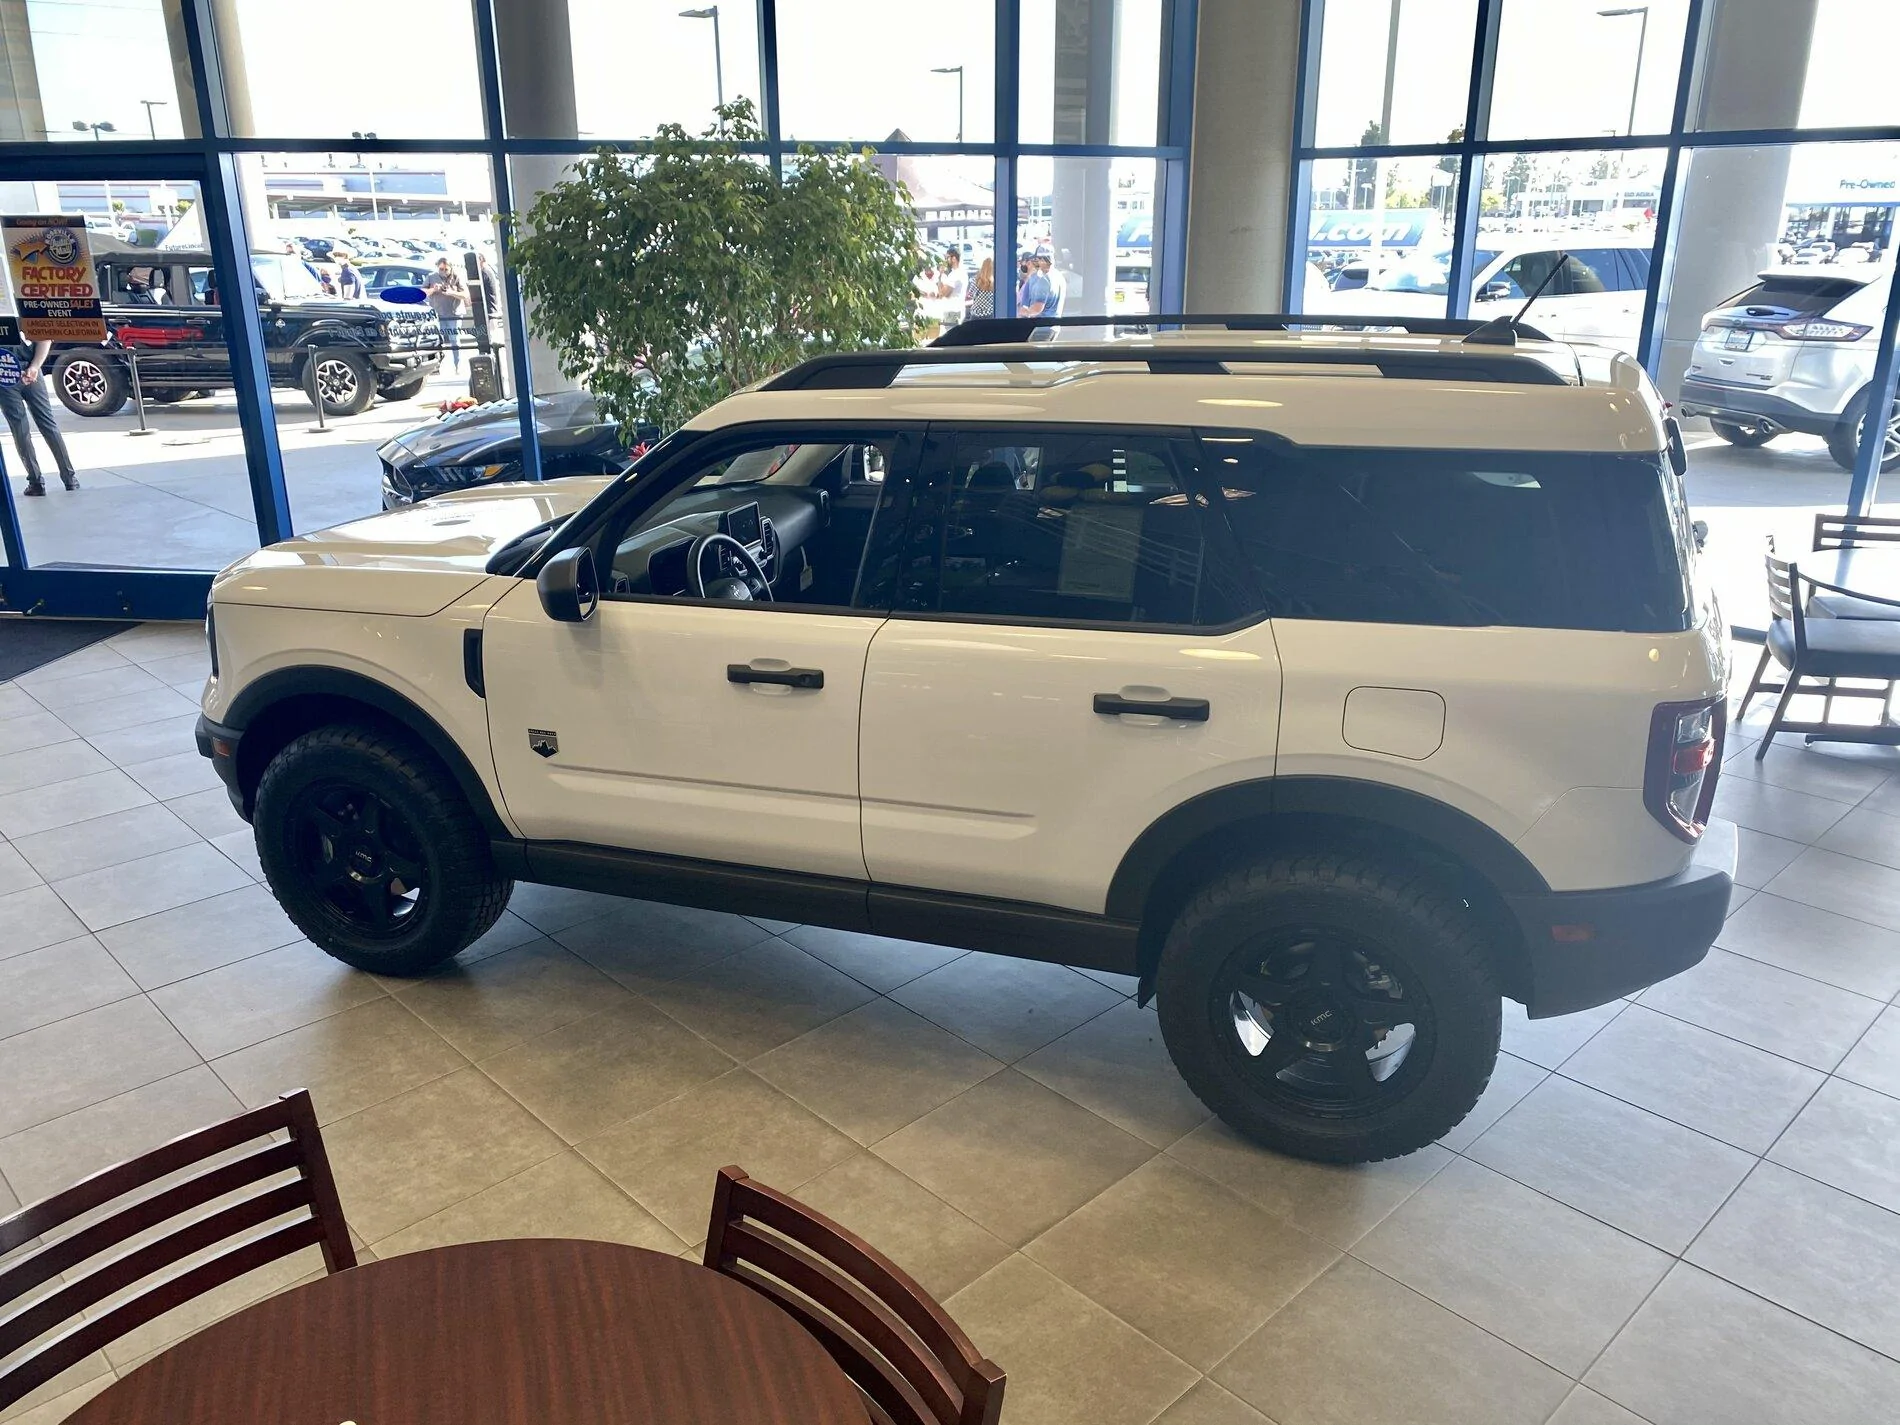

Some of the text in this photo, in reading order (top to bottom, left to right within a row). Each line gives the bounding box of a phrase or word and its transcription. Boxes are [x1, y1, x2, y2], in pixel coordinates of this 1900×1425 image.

[1840, 179, 1896, 189] Pre-Owned
[925, 209, 994, 221] BRONC
[22, 266, 87, 282] FACTORY
[21, 283, 94, 298] CERTIFIED
[23, 300, 94, 310] PRE-OWNED SALES
[47, 309, 72, 318] EVENT
[27, 319, 100, 328] LARGEST SELECTION IN
[27, 329, 102, 337] NORTHERN CALIFORNIA
